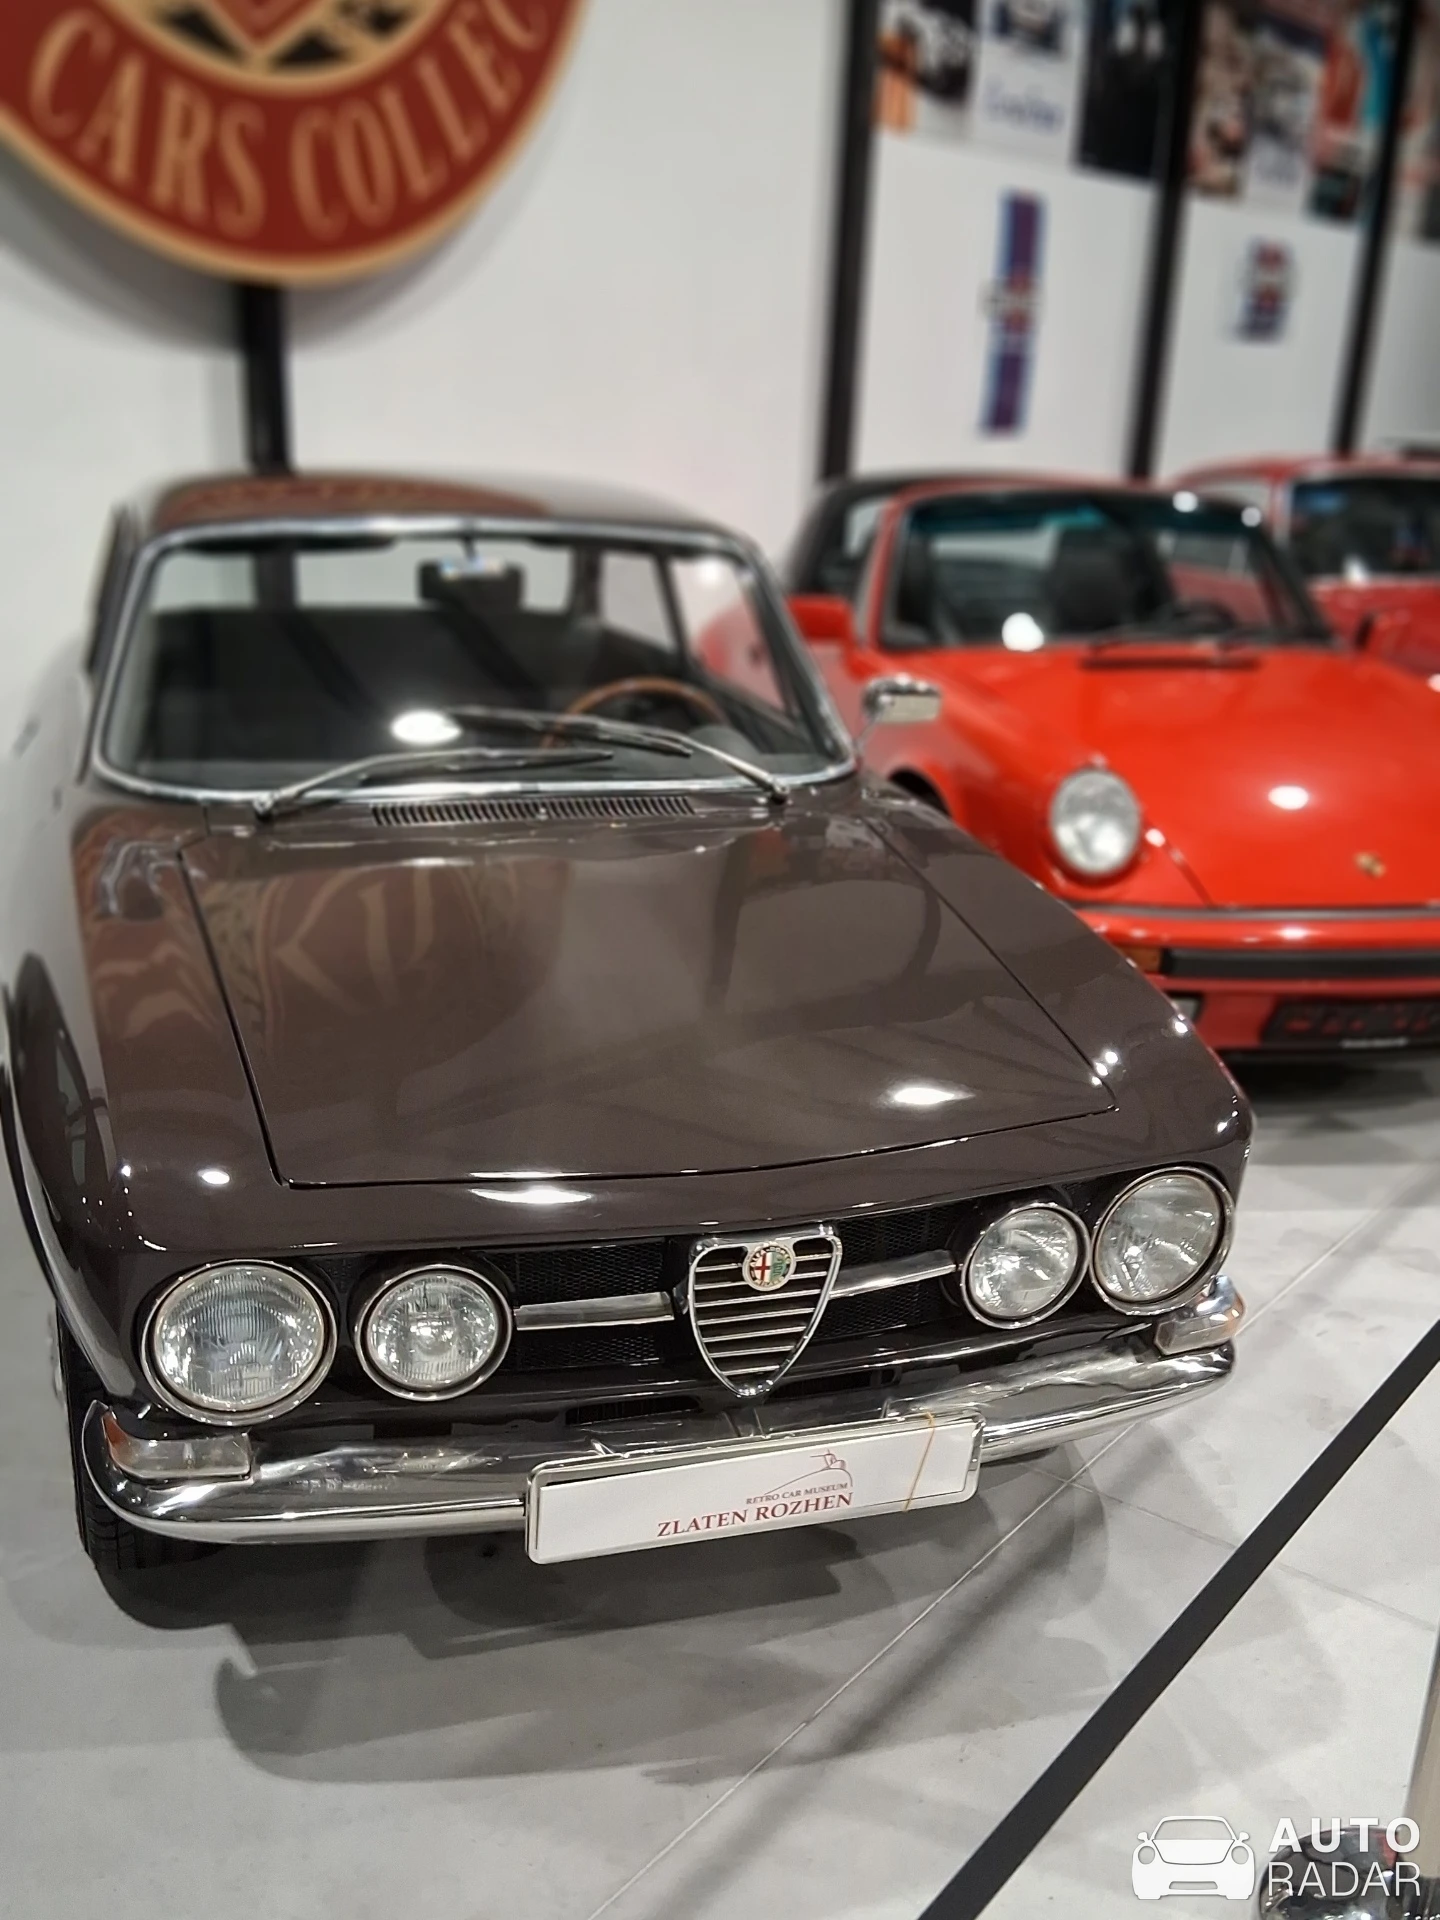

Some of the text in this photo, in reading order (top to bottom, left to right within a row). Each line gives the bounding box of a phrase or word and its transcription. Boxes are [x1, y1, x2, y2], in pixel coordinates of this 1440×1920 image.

[29, 5, 267, 238] CARS
[657, 1493, 853, 1537] ZLATEN ROZHEN
[746, 1483, 849, 1505] RETRO CAR MUSEUM
